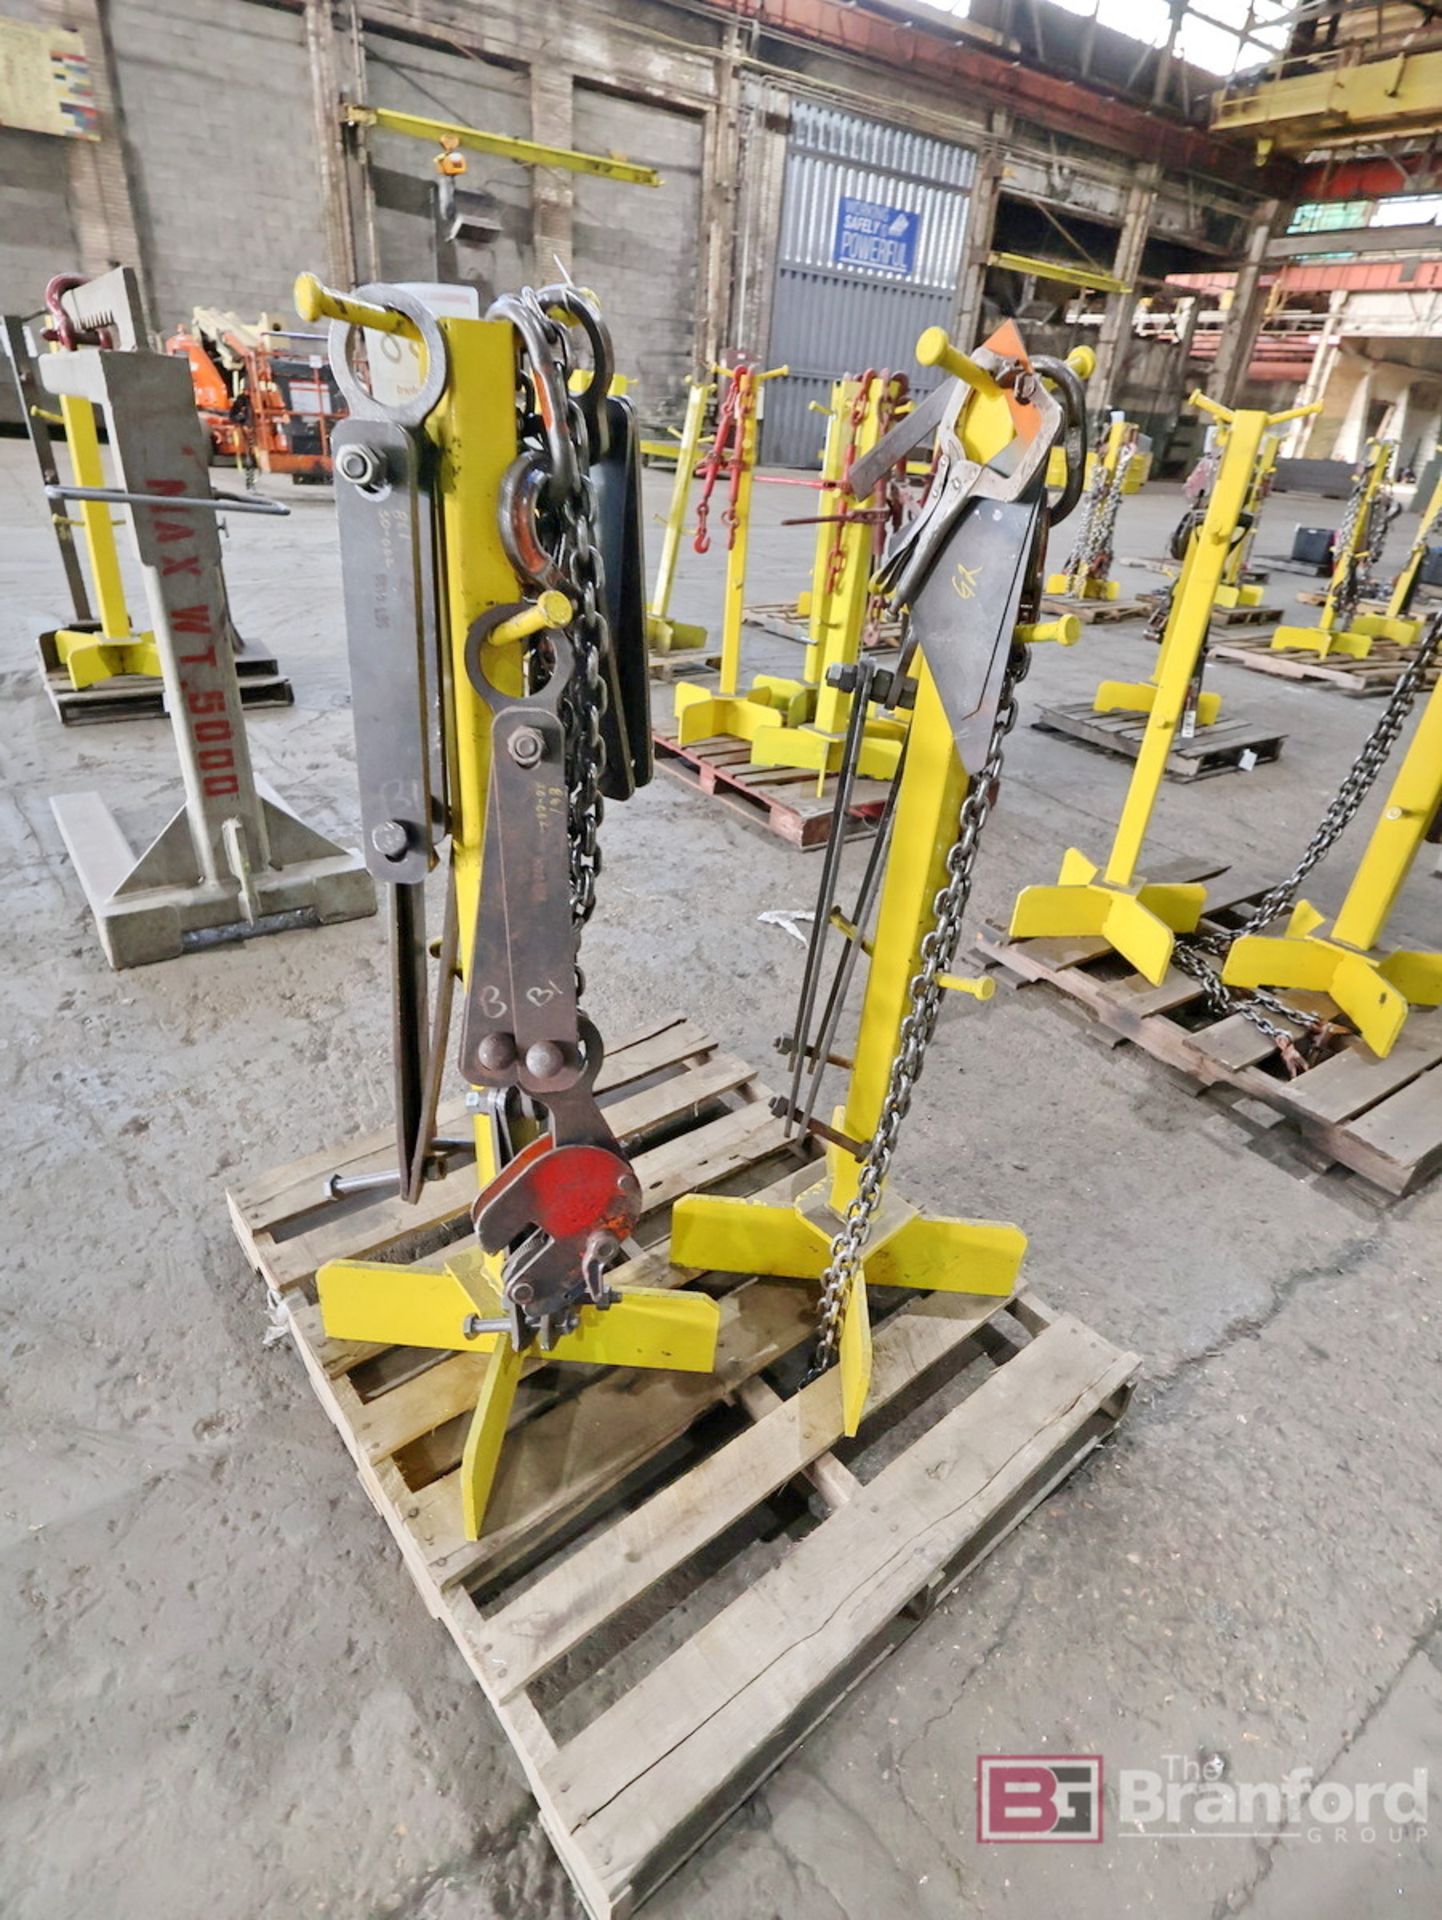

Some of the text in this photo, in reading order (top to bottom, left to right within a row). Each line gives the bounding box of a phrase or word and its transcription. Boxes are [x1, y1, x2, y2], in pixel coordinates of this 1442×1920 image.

[843, 214, 881, 234] SAFELY
[841, 230, 906, 267] POWERFUL
[144, 478, 202, 577] MAX
